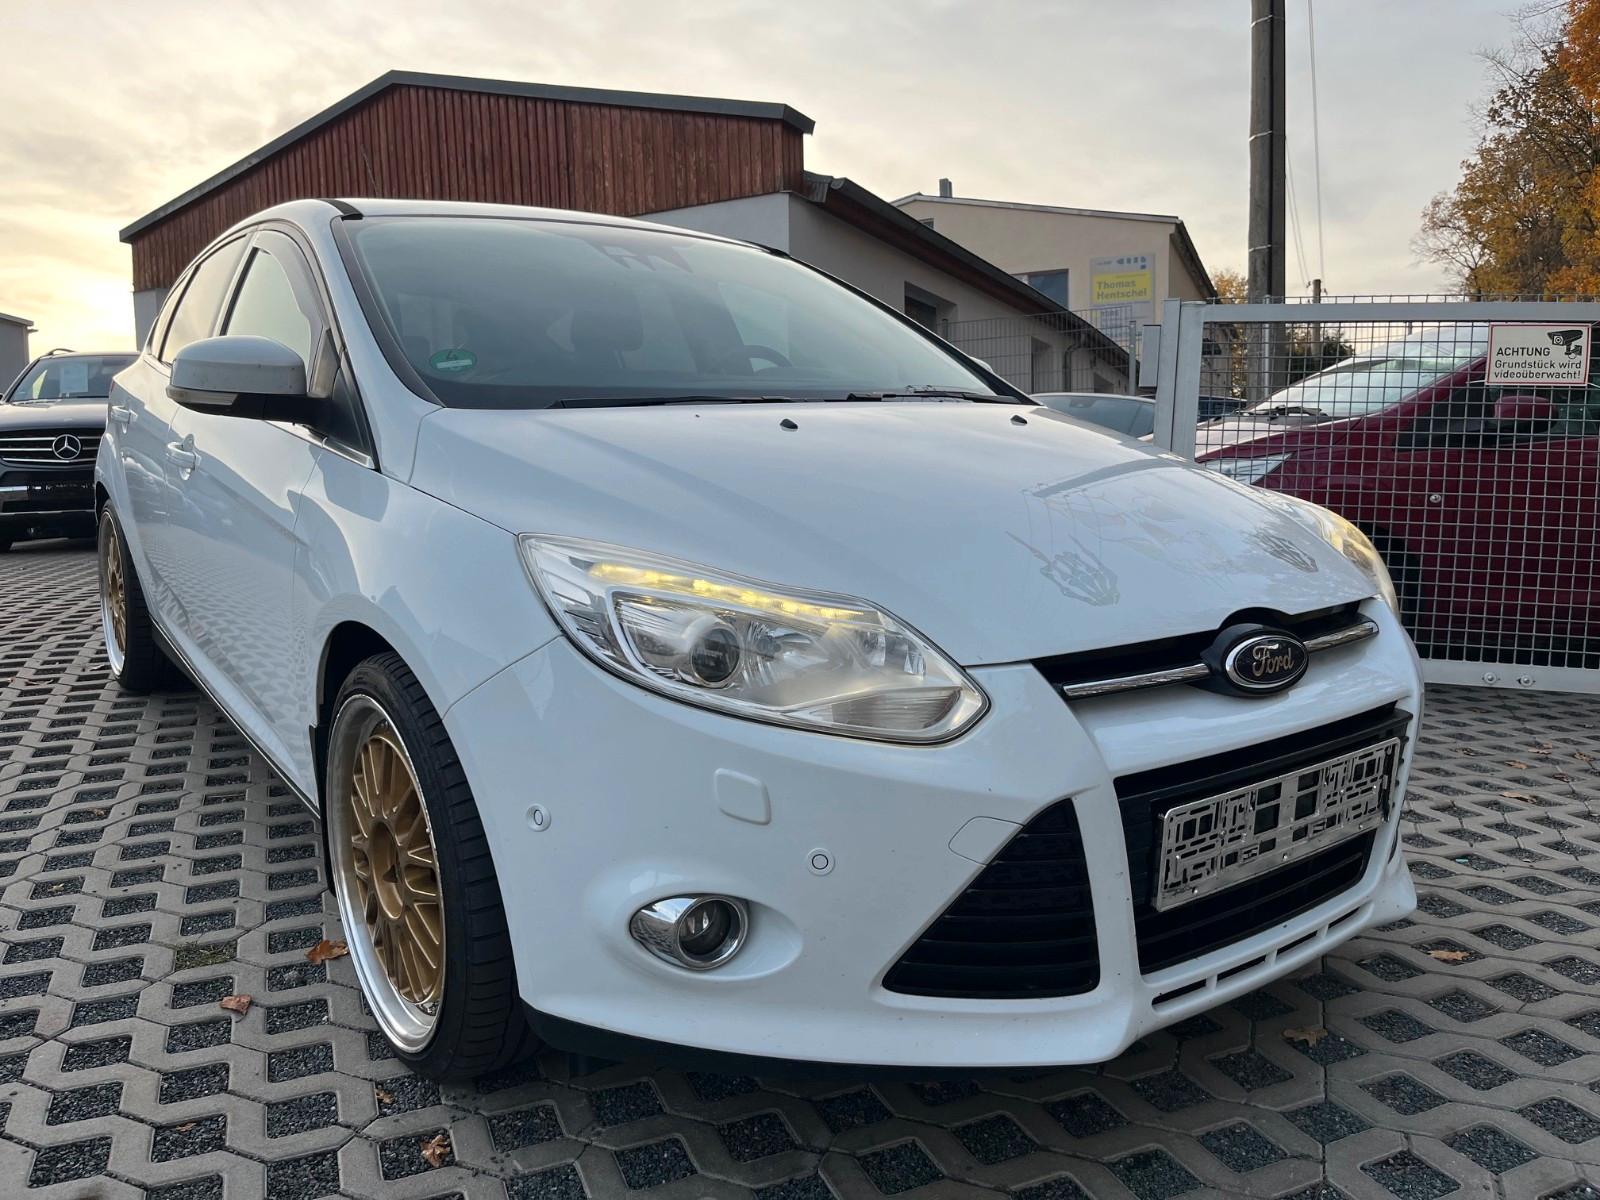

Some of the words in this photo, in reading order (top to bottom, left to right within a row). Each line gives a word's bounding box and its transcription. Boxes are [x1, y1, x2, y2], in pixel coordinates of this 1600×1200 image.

[1096, 280, 1137, 290] Thomas
[1096, 288, 1147, 300] Hentschel
[1496, 347, 1551, 356] ACHTUNG
[1494, 359, 1556, 369] Grundstück
[1558, 360, 1582, 369] wird
[1494, 370, 1581, 379] videoüberwacht!
[1252, 643, 1295, 677] Ford
